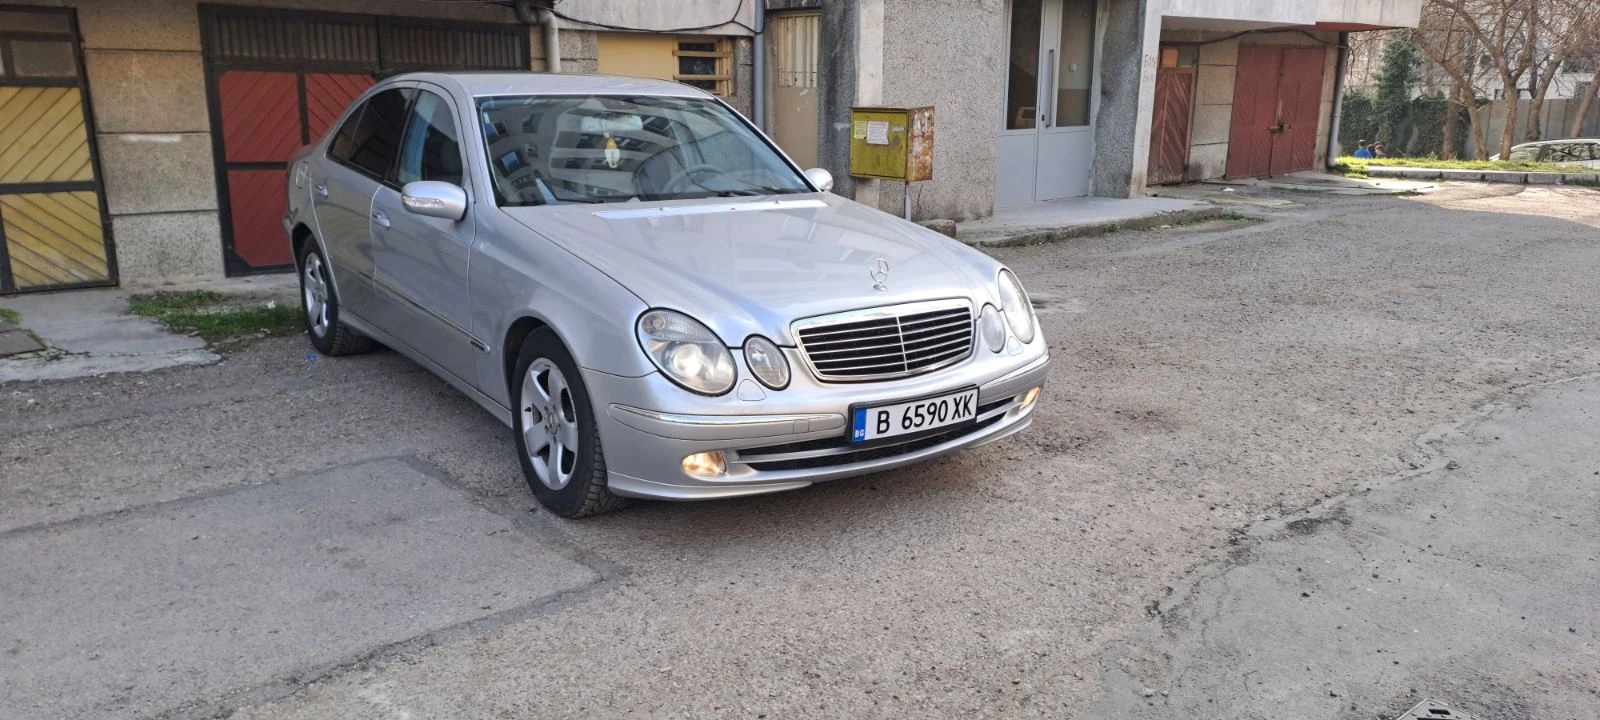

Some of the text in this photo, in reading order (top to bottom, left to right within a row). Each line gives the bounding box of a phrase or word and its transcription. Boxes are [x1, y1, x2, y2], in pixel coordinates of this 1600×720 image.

[877, 394, 974, 434] B 6590 XK
[855, 429, 865, 438] BG
